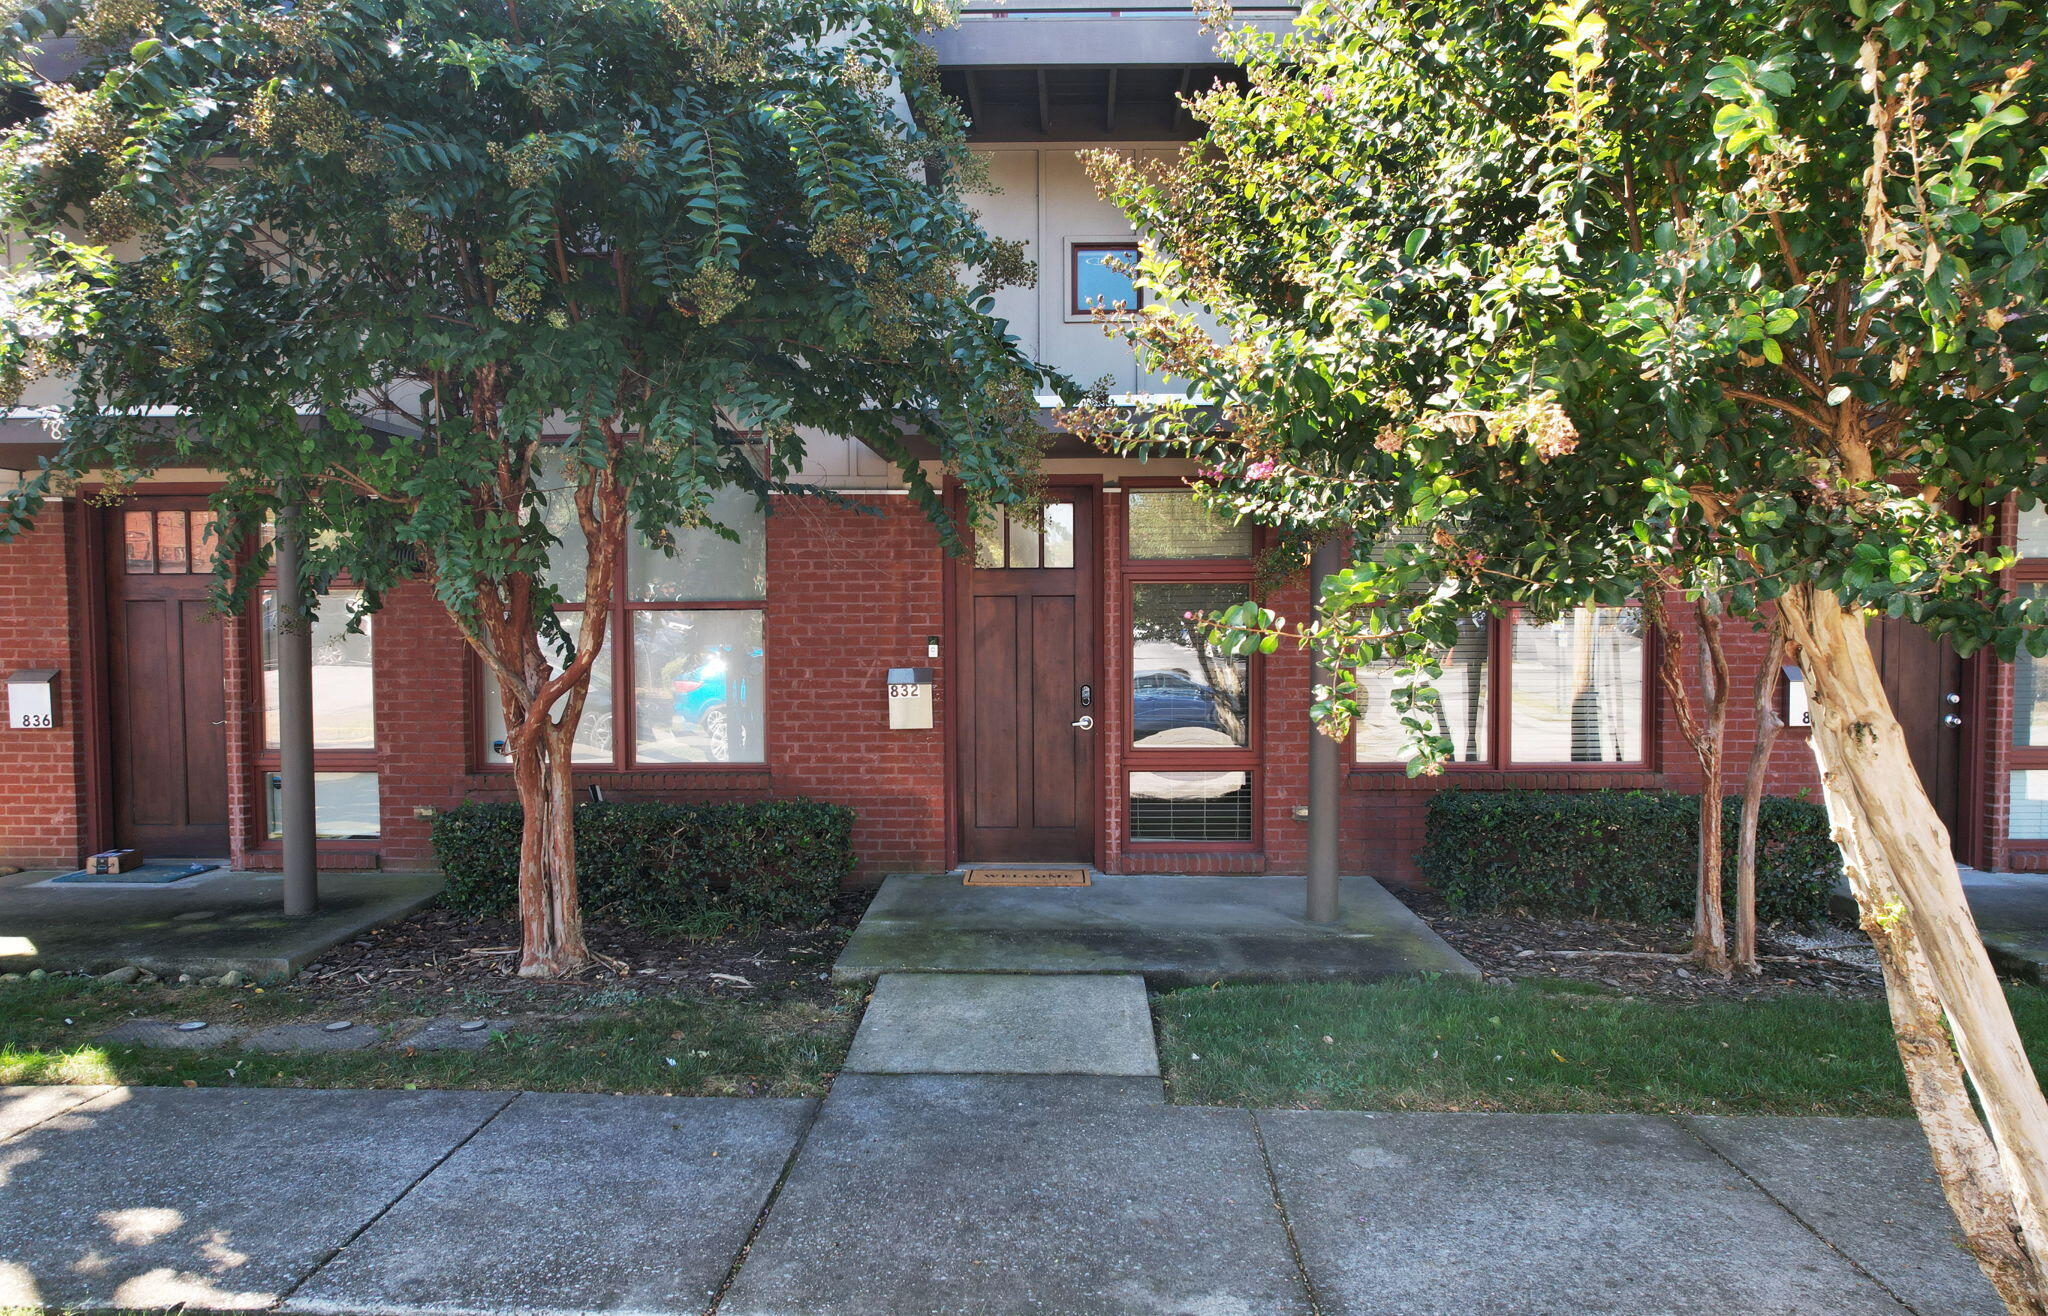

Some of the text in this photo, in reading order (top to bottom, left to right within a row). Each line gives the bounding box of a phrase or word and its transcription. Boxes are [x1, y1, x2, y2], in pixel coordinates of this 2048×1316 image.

[890, 684, 919, 698] 832
[22, 714, 51, 727] 836
[983, 872, 1073, 880] WELCOME
